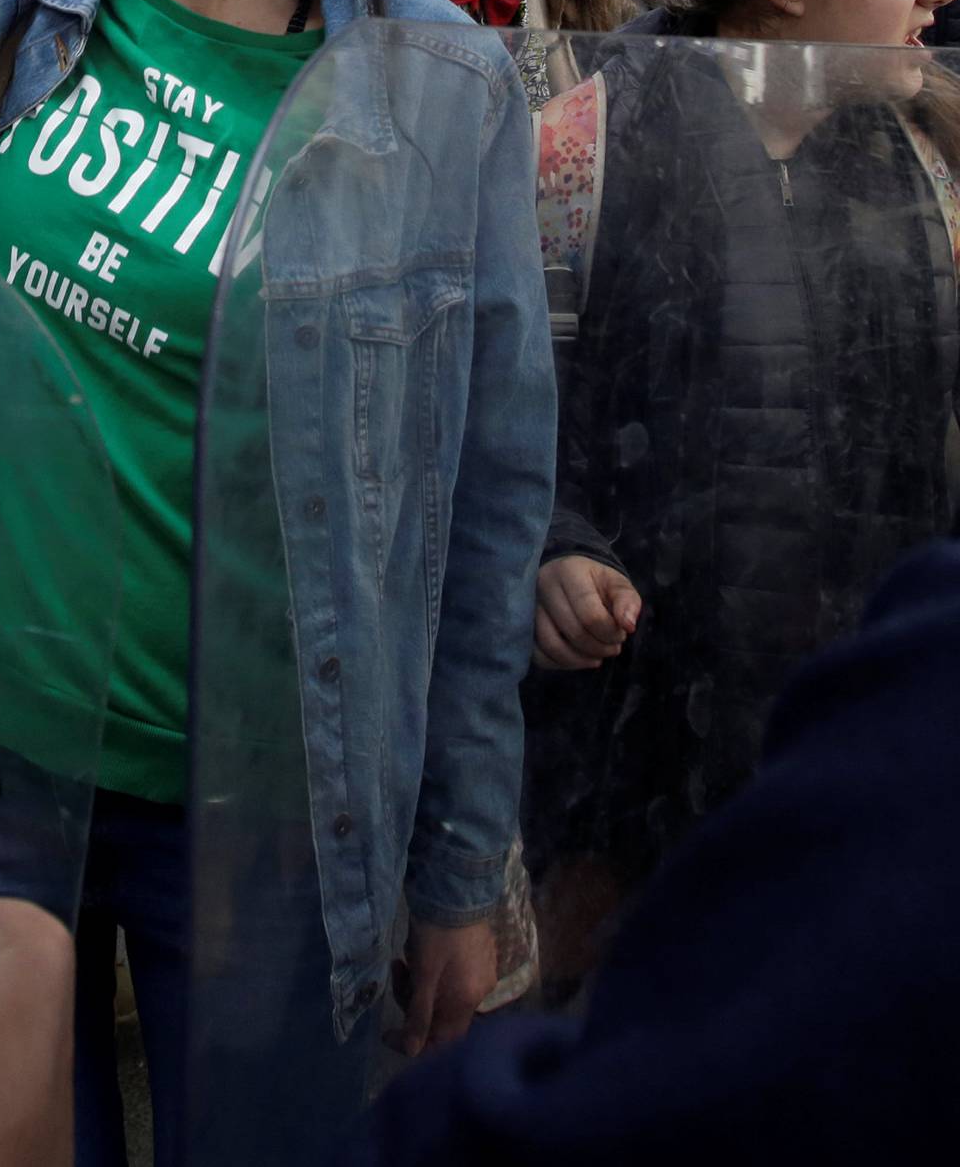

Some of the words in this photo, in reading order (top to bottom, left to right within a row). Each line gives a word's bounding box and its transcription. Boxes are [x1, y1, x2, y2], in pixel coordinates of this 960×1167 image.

[143, 66, 224, 124] STAY
[78, 230, 130, 284] BE
[6, 244, 169, 359] YOURSELF
